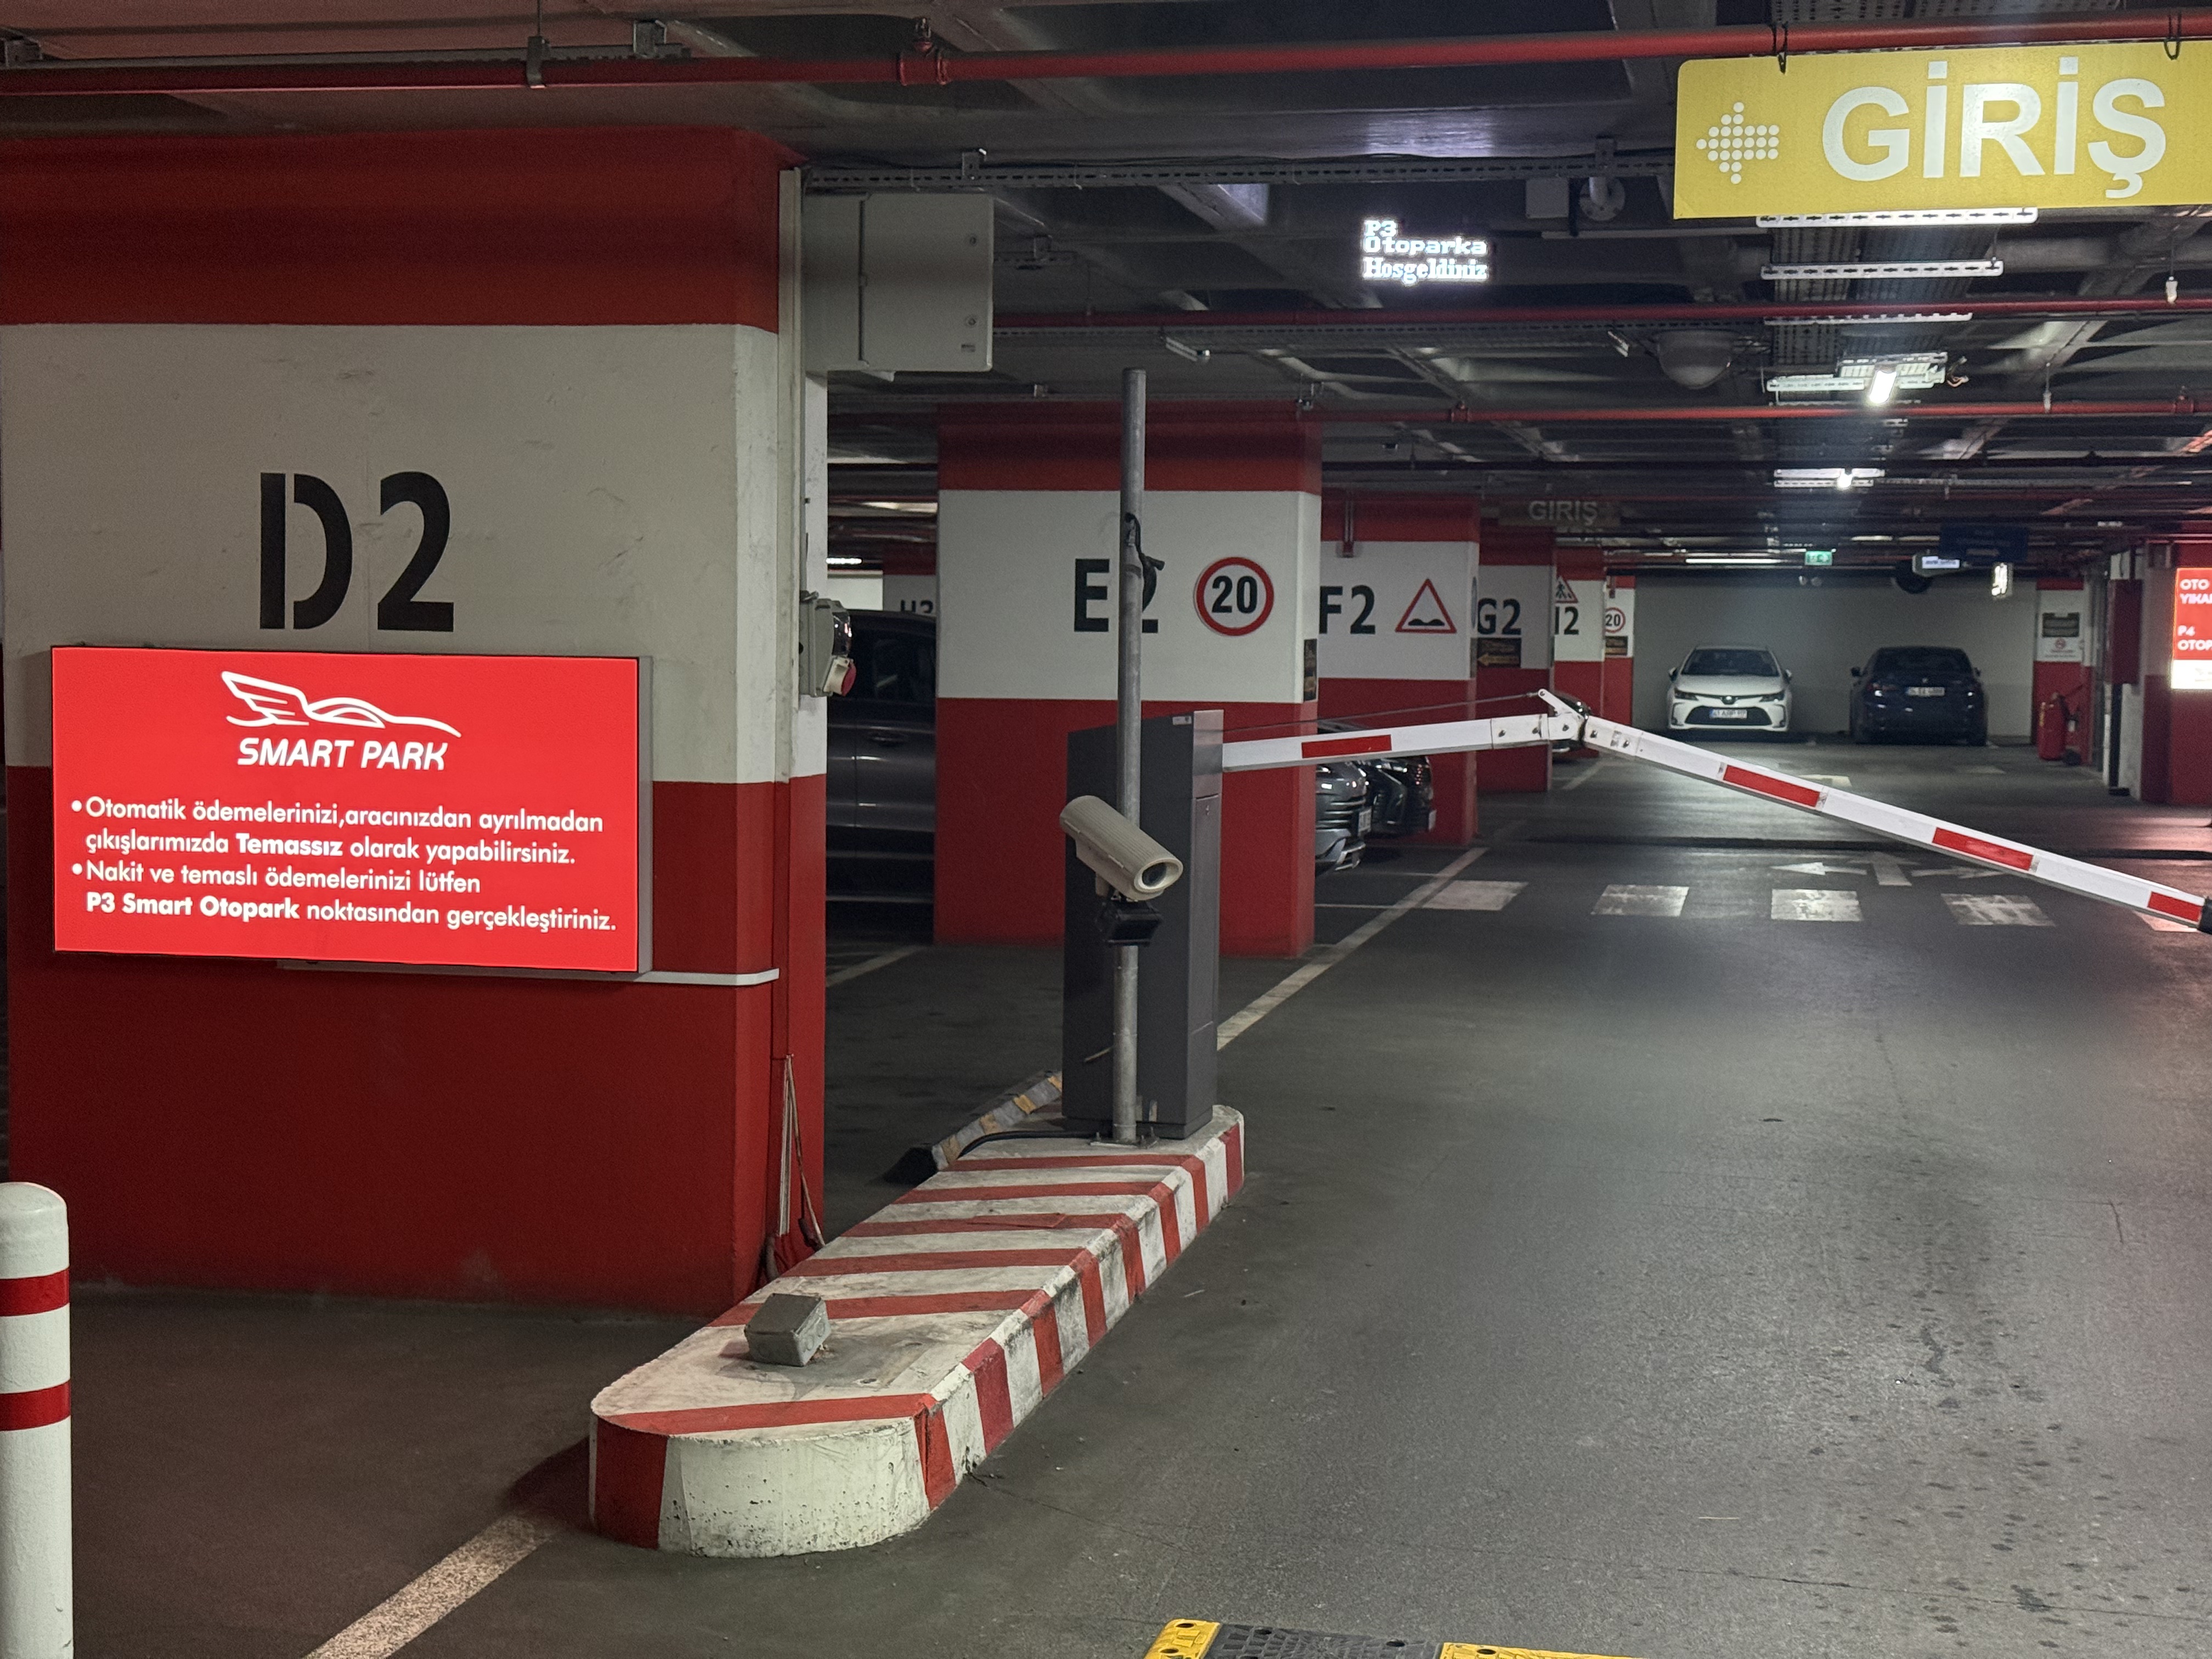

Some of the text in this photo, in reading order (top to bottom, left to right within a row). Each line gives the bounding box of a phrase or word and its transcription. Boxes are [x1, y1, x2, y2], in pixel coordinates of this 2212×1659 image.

[1822, 57, 2166, 199] GİRİŞ
[1364, 219, 1398, 237] P3
[1364, 236, 1487, 256] Otoparka
[259, 471, 454, 632] D2
[1211, 575, 1258, 614] 20
[2180, 579, 2209, 590] OTO
[2180, 593, 2212, 605] YIKA
[1318, 584, 1376, 635] F2
[1477, 597, 1522, 635] G2
[1605, 614, 1621, 627] 20
[2177, 625, 2196, 636] P4
[2177, 640, 2212, 651] OTOP
[238, 738, 448, 771] SMART PARK
[86, 796, 187, 820] Otomatik
[479, 808, 603, 834] ayrılmadan
[86, 827, 575, 865] çıkışlarımızda Temassız olarak yapabilirsiniz.
[87, 860, 480, 893] Nakit ve temaslı ödemelerinizi lütfen
[87, 891, 616, 933] P3 Smart Otopark noktasından gerçekleştiriniz.
